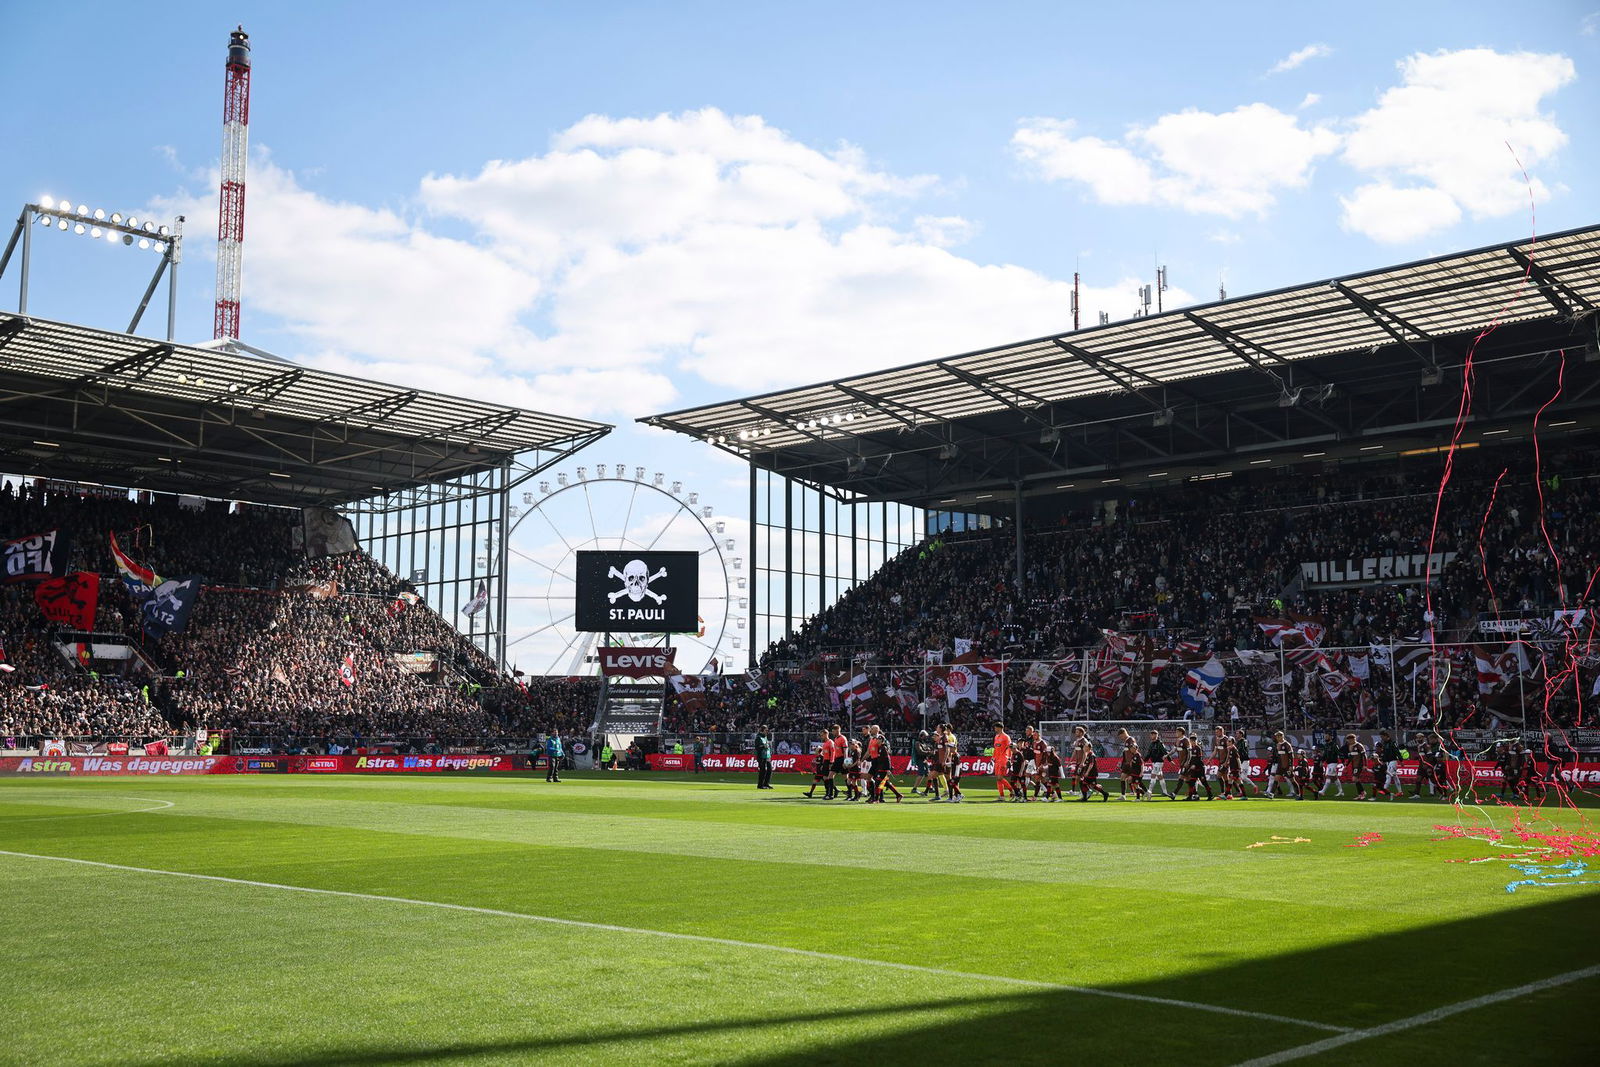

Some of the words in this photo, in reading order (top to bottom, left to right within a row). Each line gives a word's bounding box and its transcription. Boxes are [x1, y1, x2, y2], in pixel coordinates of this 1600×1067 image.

[609, 609, 625, 620] ST.
[627, 609, 665, 620] PAULI
[17, 758, 76, 772] Astra.
[83, 758, 122, 772] Was
[127, 758, 215, 774] dagegen?
[309, 761, 334, 769] ASTRA
[355, 757, 398, 768] Astra.
[403, 757, 432, 768] Was
[435, 756, 501, 770] dagegen?
[701, 758, 722, 768] stra.
[725, 757, 744, 768] Was
[747, 757, 795, 770] dagen?
[1560, 768, 1600, 782] stra
